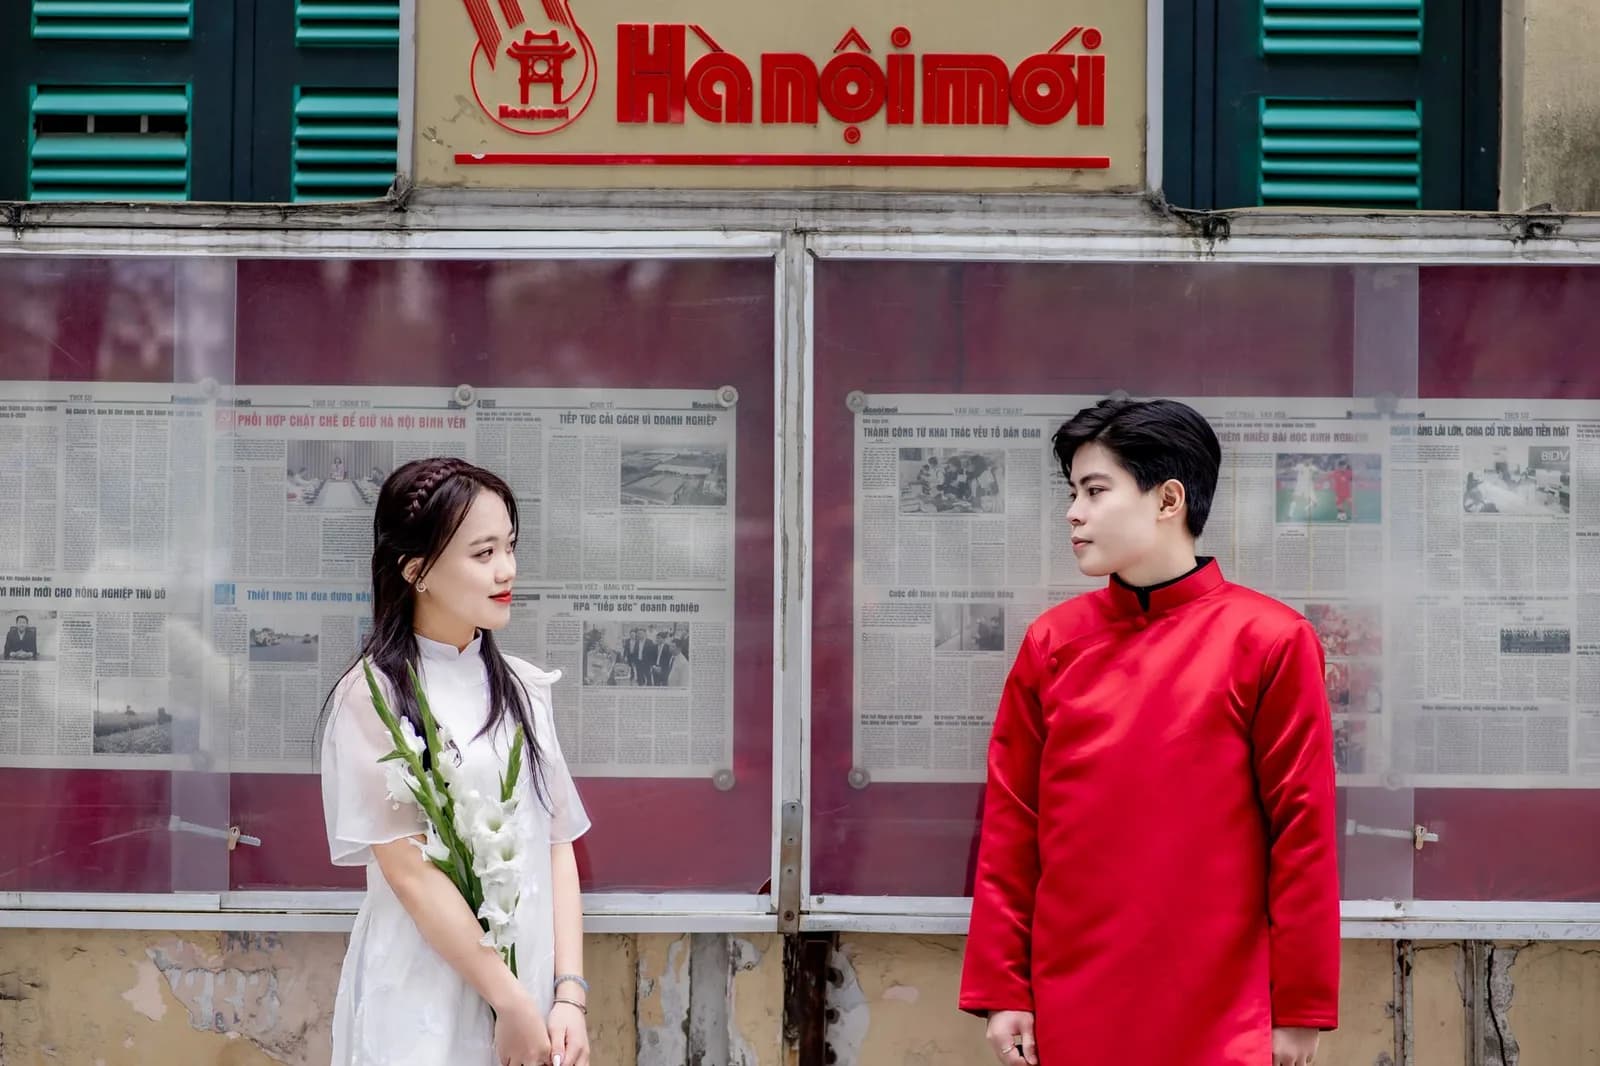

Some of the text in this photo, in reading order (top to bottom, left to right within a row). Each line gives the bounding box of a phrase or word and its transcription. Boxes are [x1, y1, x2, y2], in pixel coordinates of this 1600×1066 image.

[238, 412, 262, 428] PHỐI
[266, 413, 286, 428] HỢP
[290, 412, 315, 429] CHẶT
[319, 412, 338, 428] CHẼ
[342, 411, 356, 428] ĐỂ
[359, 412, 376, 428] GIỮ
[380, 413, 394, 428] HÀ
[397, 414, 414, 430] NỘI
[419, 414, 444, 429] BÌNH
[448, 414, 466, 429] YÊN
[560, 412, 717, 427] TIẾP TỤC CẢI CÁCH VÌ DOANH NGHIỆP
[864, 425, 1041, 438] THÀNH CÔNG TỪ KHAI THÁC YẾU TỐ DÂN GIAN
[1243, 430, 1270, 442] NHIỀU
[1272, 430, 1287, 442] BÀI
[1290, 432, 1307, 444] HỌC
[1310, 432, 1330, 443] KINH
[1434, 424, 1446, 436] LÃI
[1448, 424, 1463, 438] LỚN,
[1466, 426, 1483, 436] CHIA
[1484, 422, 1495, 436] CỔ
[1498, 423, 1512, 437] TỨC
[1512, 424, 1534, 437] BẰNG
[1535, 424, 1551, 437] TIỀN
[1552, 425, 1570, 438] MẶT
[10, 584, 30, 598] NHÌN
[34, 584, 52, 598] MỚI
[54, 588, 72, 598] CHO
[75, 586, 98, 598] NÔNG
[102, 587, 134, 600] NGHIỆP
[135, 584, 152, 600] THỦ
[154, 586, 166, 600] ĐÔ
[247, 588, 268, 601] Thiết
[272, 590, 292, 603] thực
[296, 590, 307, 602] thi
[310, 591, 328, 602] đua
[640, 602, 666, 612] doanh
[670, 602, 700, 614] nghiệp
